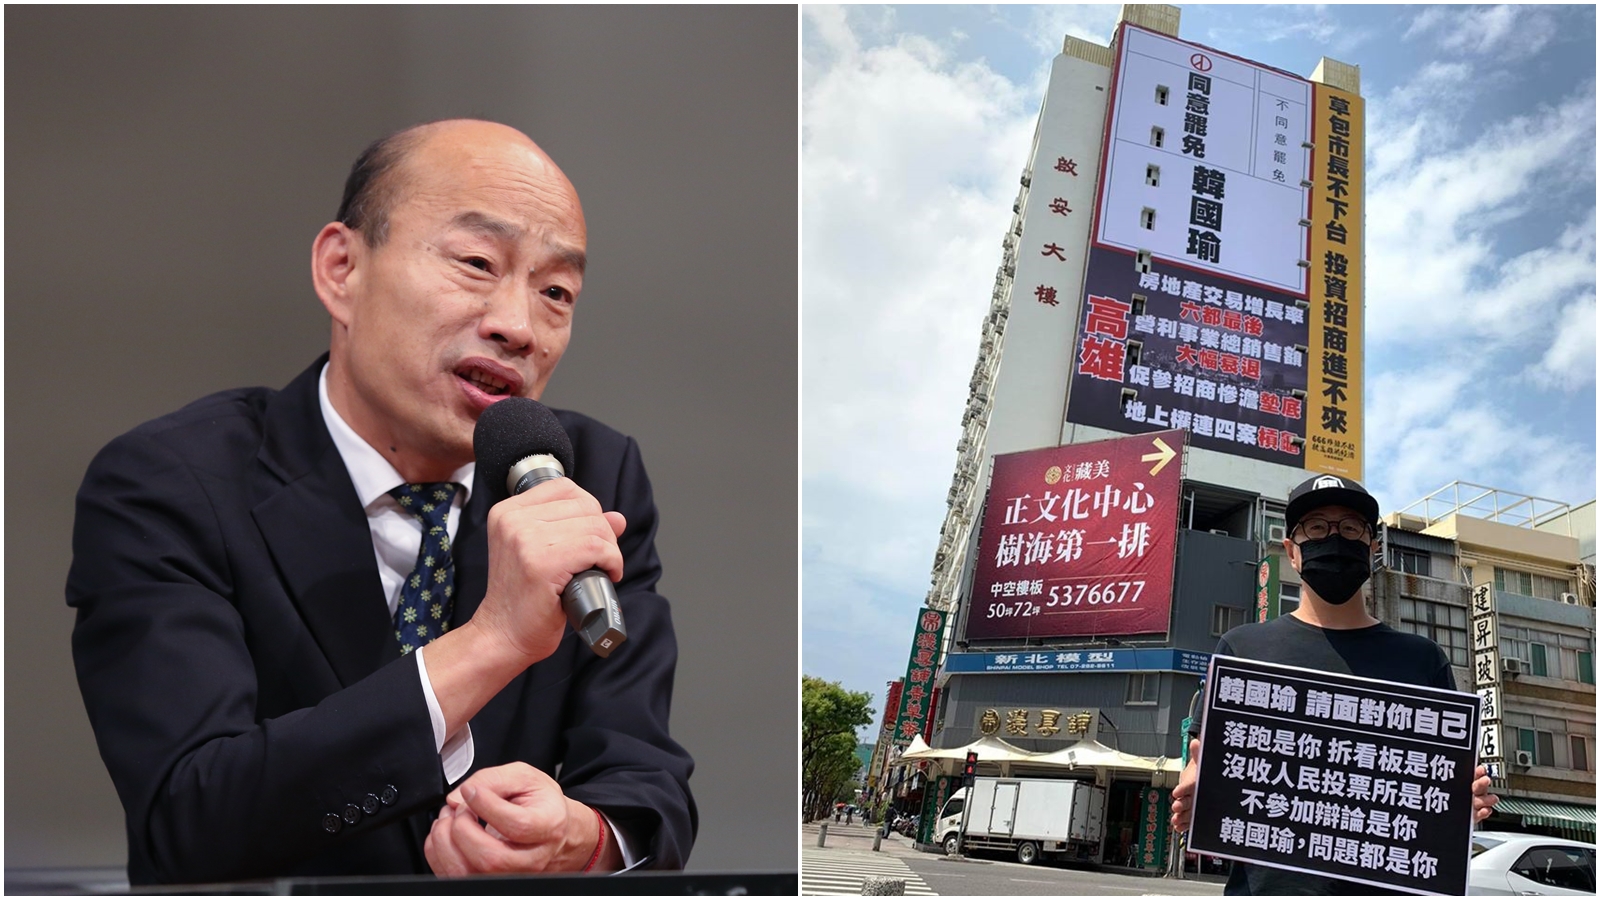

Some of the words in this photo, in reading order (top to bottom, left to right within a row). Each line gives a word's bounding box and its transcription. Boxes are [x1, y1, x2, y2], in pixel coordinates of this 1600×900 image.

[1182, 71, 1212, 159] 同意罷免
[1272, 99, 1290, 183] 不同意罷免
[1325, 95, 1351, 244] 草包市長不下台
[1186, 165, 1226, 264] 韓國瑜
[1138, 271, 1304, 325] 房地產交易增長率
[1180, 301, 1264, 337] 六都最後
[1079, 294, 1131, 383] 高雄
[1134, 314, 1303, 368] 營利事業總銷售額
[1175, 345, 1261, 381] 大幅衰退
[1322, 250, 1349, 434] 投資招商進不來
[1001, 482, 1155, 526] 正文化中心
[994, 522, 1152, 568] 樹海第一排
[990, 579, 1044, 598] 中空樓板
[1046, 581, 1146, 607] 5376677
[995, 652, 1114, 664] 新北模型
[1474, 586, 1495, 756] 建昇玻璃店
[1218, 676, 1297, 713] 韓國瑜
[1305, 689, 1468, 740] 請面對你自己
[1222, 720, 1322, 760] 落跑是你
[1327, 738, 1456, 781] 拆看板是你
[1222, 752, 1450, 814] 沒收人民投票所是你
[1240, 789, 1418, 842] 不參加辯論是你
